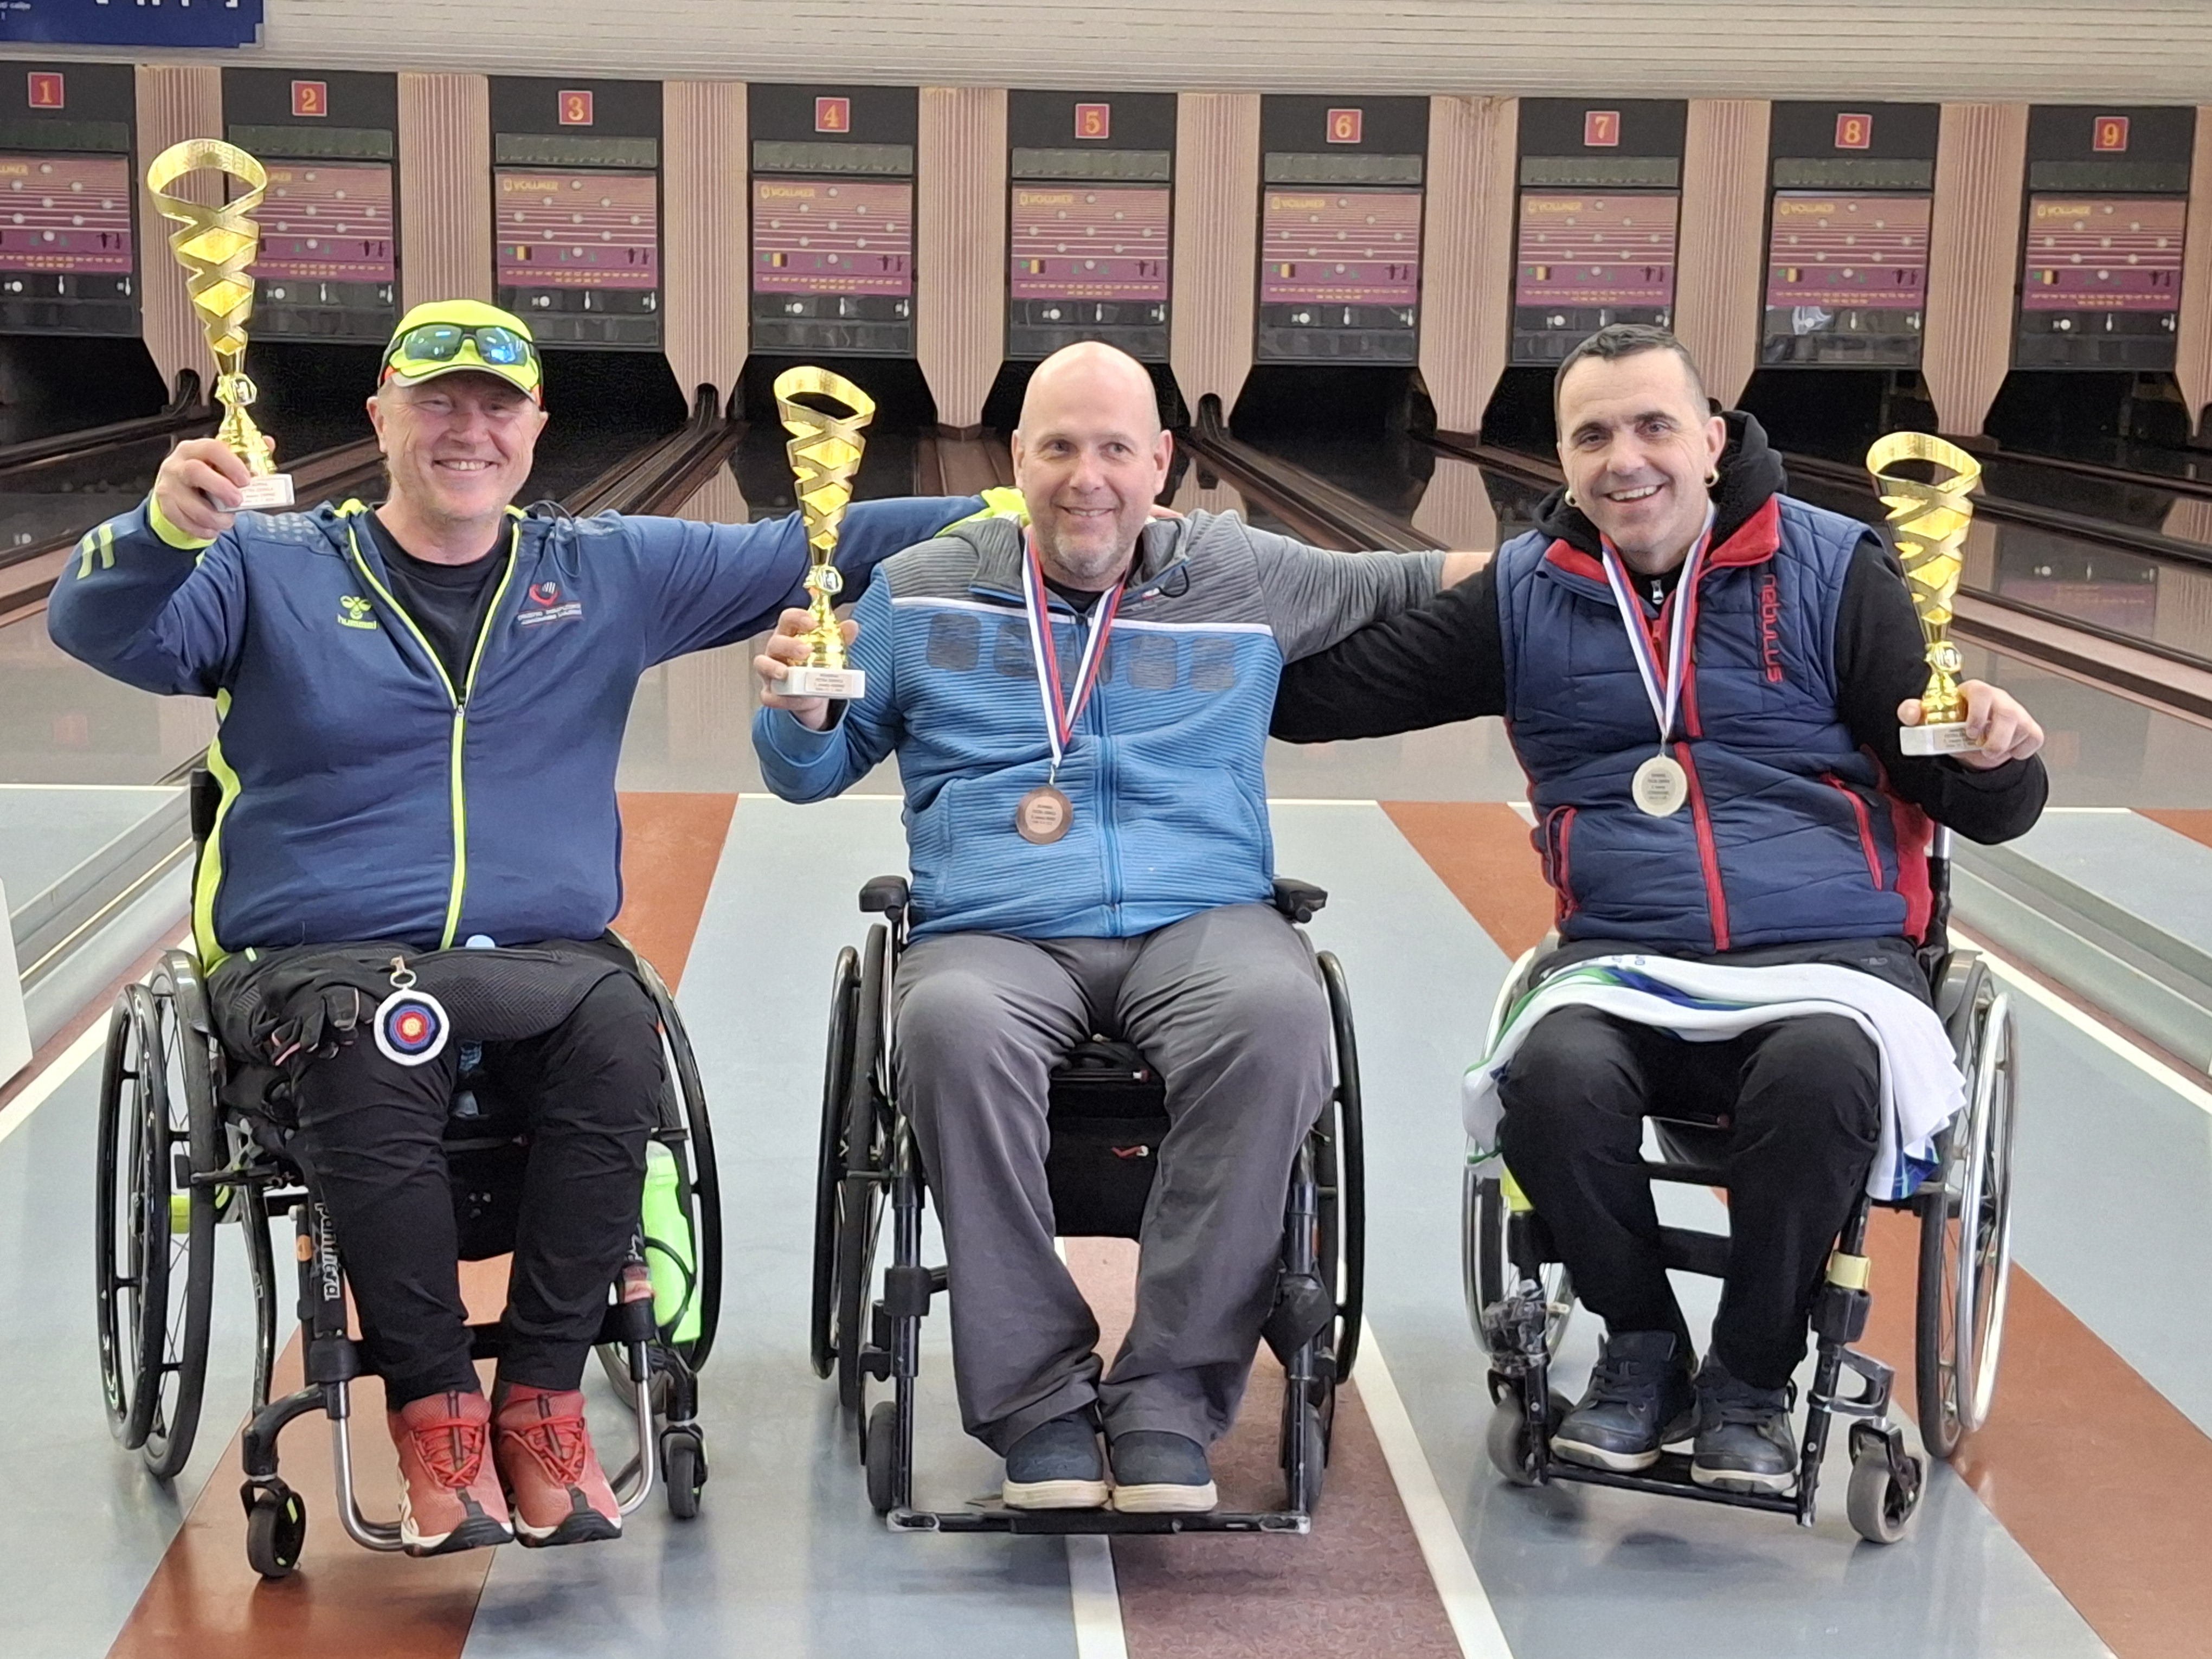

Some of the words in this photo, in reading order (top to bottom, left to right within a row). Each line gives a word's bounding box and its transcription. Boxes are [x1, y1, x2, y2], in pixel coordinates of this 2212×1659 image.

[39, 80, 52, 103] 1
[301, 88, 317, 111] 2
[568, 97, 584, 120] 3
[824, 105, 839, 127] 4
[1085, 111, 1101, 133] 5
[1335, 115, 1352, 138] 6
[1596, 116, 1609, 139] 7
[1844, 120, 1861, 143] 8
[2103, 123, 2118, 146] 9
